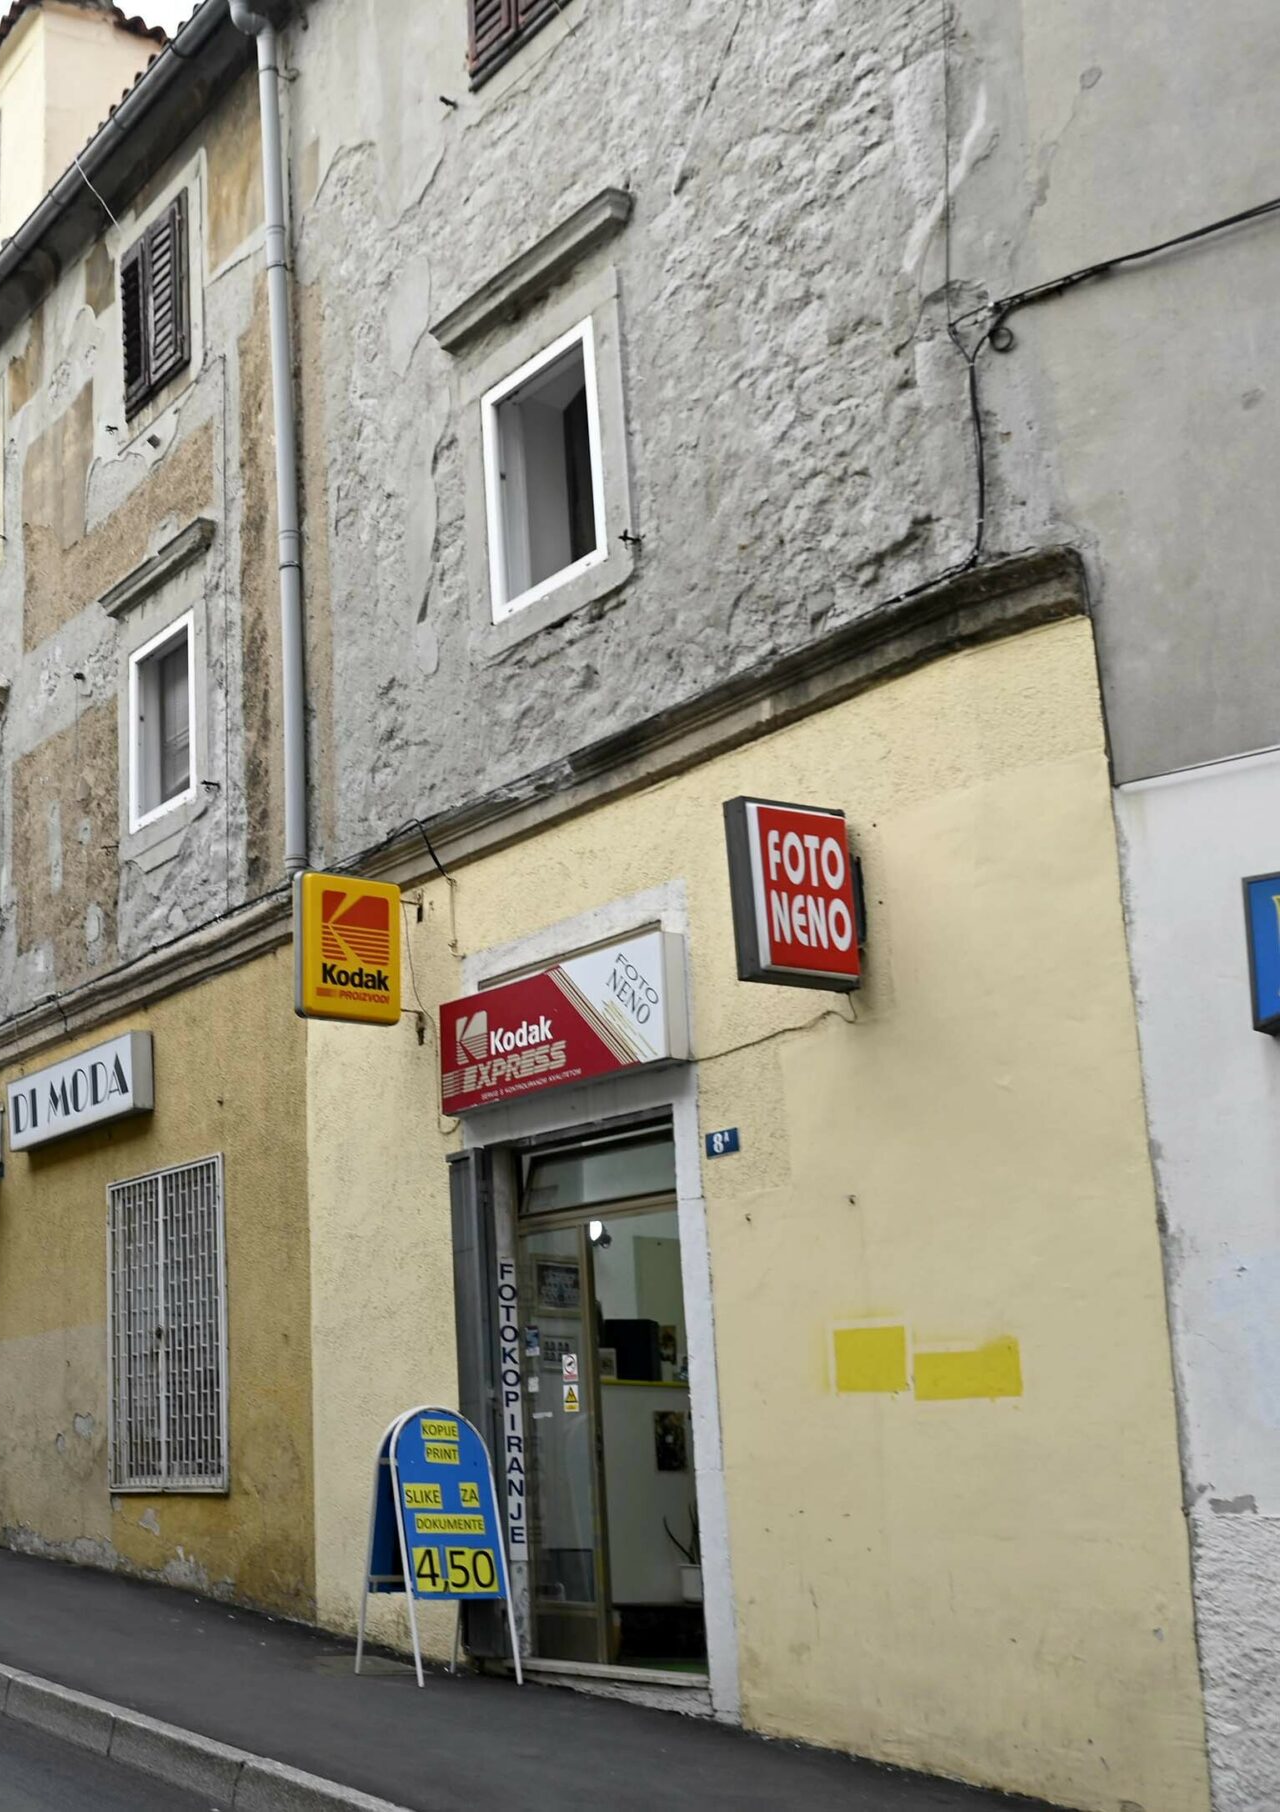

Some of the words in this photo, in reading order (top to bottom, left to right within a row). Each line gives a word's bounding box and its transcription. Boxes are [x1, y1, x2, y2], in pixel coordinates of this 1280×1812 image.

[767, 829, 845, 890] FOTO
[770, 889, 852, 952] NENO
[322, 962, 389, 992] Kodak
[605, 967, 651, 1024] NENO
[616, 953, 659, 1005] FOTO
[490, 1015, 554, 1056] Kodak
[462, 1040, 567, 1094] EXPRESS
[12, 1087, 39, 1134] DI
[47, 1051, 129, 1124] MODA
[712, 1131, 730, 1154] 8A
[498, 1263, 525, 1544] FOTOKOPIRANJE
[422, 1423, 458, 1437] KOPIJE
[426, 1447, 458, 1461] PRINT
[405, 1488, 441, 1504] SLIKE
[461, 1488, 479, 1503] ZA
[416, 1518, 484, 1531] DOKUMENTE
[416, 1549, 496, 1593] 4,50
